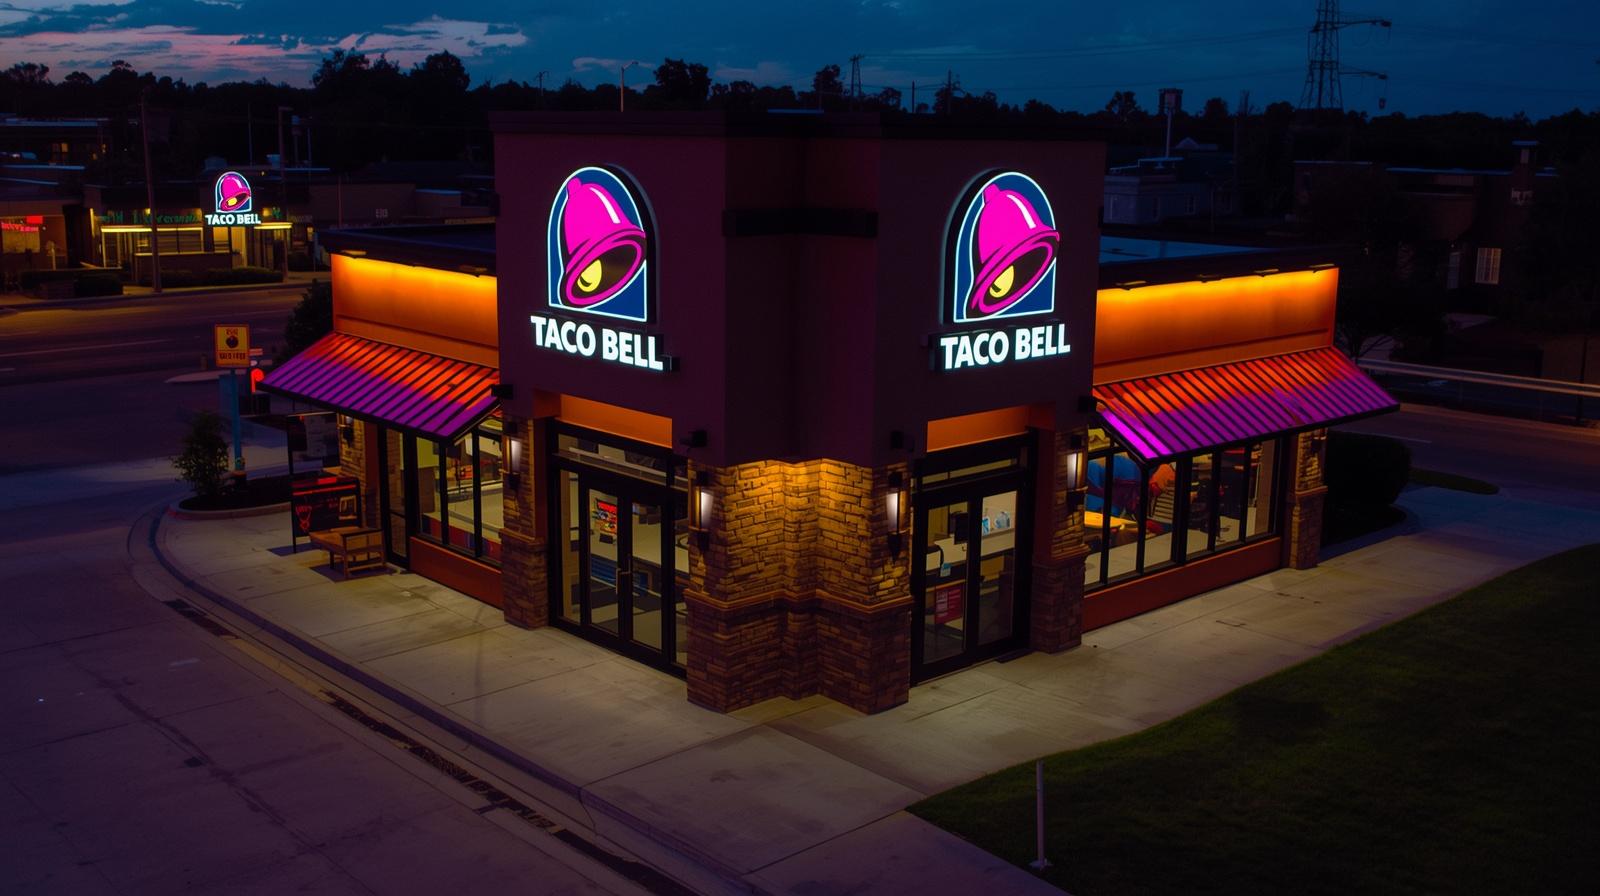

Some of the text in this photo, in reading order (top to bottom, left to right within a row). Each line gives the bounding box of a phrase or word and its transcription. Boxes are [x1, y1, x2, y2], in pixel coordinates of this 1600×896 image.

[205, 213, 236, 225] TACO
[236, 213, 262, 225] BELL
[530, 315, 664, 371] TACO BELL
[940, 323, 1071, 370] TACO BELL
